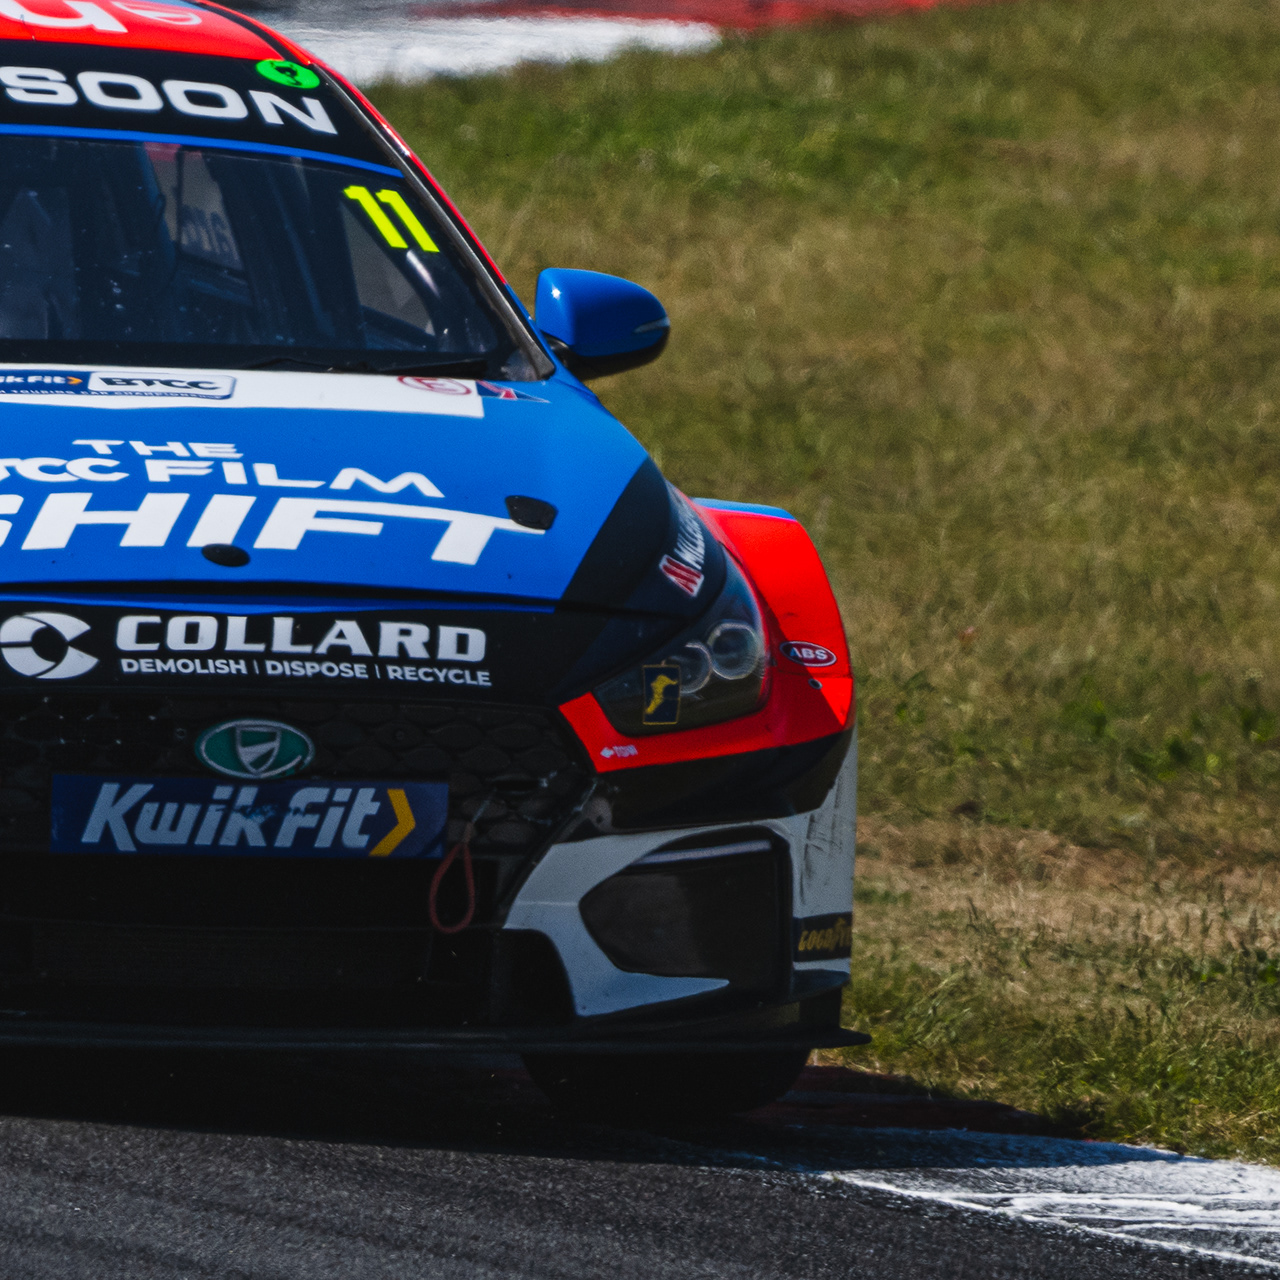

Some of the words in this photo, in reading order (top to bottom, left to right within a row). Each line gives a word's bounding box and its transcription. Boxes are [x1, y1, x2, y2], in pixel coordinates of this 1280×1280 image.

[344, 185, 440, 252] 11
[99, 376, 221, 391] BTCC
[72, 439, 244, 459] THE
[144, 460, 446, 497] FILM
[115, 615, 488, 663] COLLARD
[790, 647, 828, 660] ABS
[120, 657, 247, 675] DEMOLISH
[265, 660, 369, 679] DISPOSE
[387, 665, 493, 687] RECYCLE
